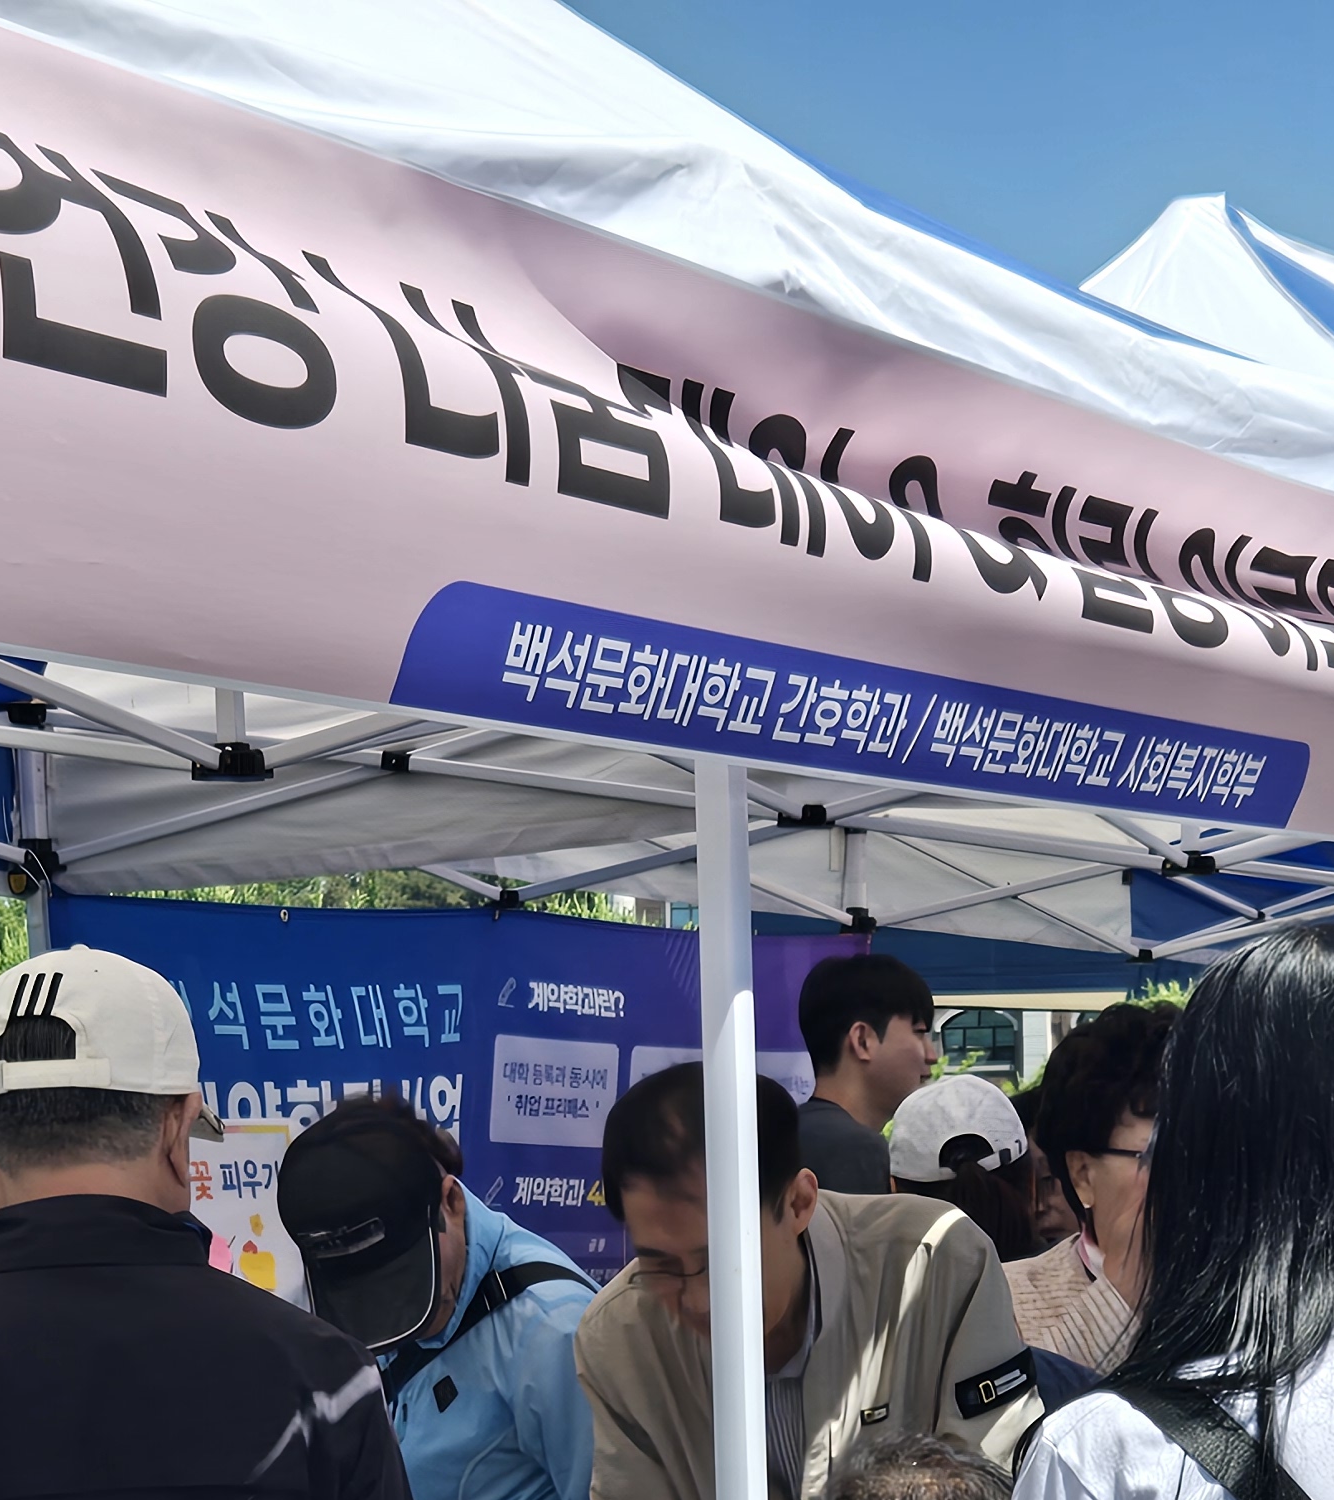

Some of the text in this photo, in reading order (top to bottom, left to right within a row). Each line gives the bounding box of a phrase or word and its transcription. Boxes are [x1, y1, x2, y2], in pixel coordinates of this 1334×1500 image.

[502, 621, 777, 736] 백석문화대학교
[771, 673, 912, 758] 간호학과
[929, 699, 1126, 787] 백석문화대학교
[1117, 735, 1268, 808] 사회복지학부
[527, 980, 625, 1019] 계약학과란?
[502, 1061, 530, 1086] 대학
[569, 1066, 608, 1090] 동시에
[512, 1176, 585, 1207] 계약학과
